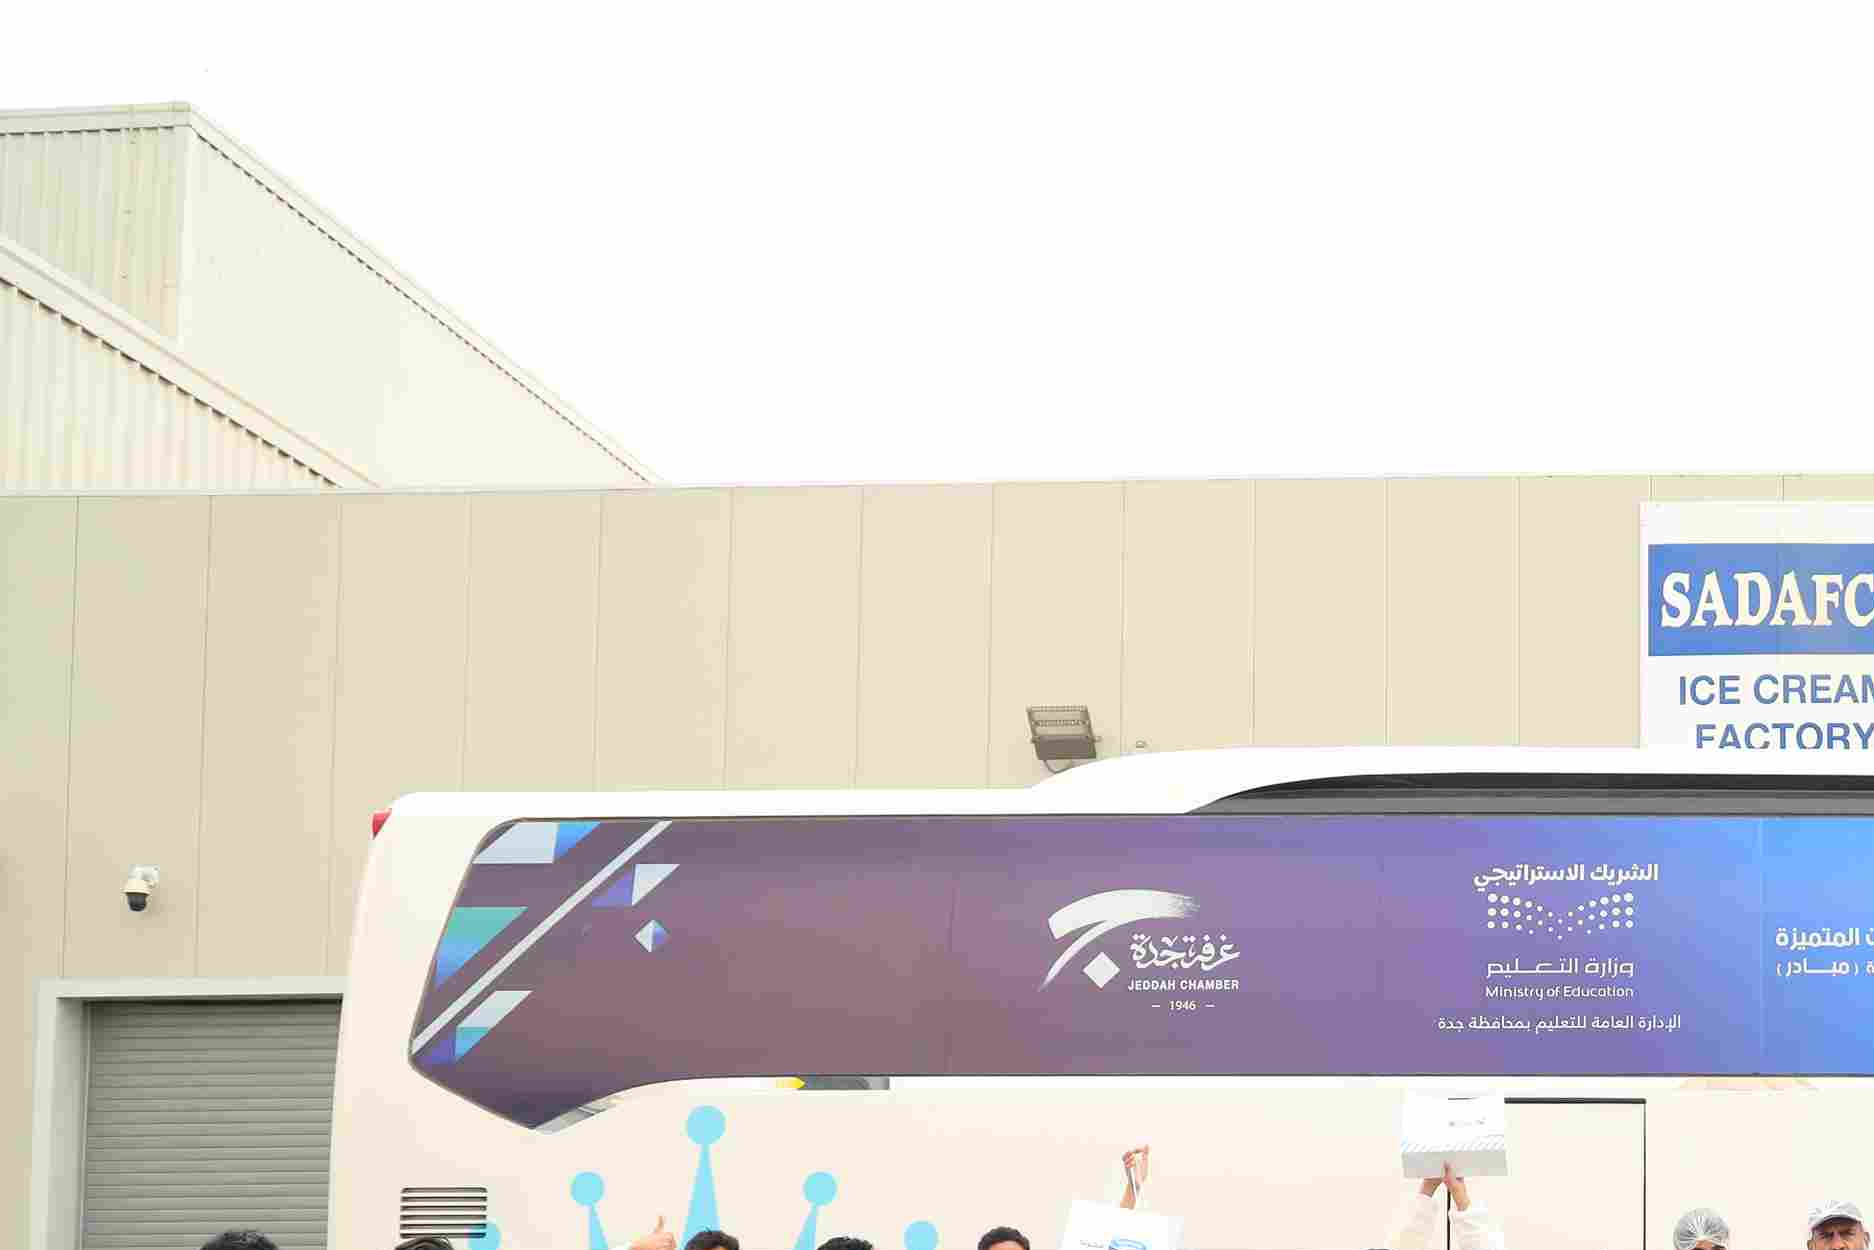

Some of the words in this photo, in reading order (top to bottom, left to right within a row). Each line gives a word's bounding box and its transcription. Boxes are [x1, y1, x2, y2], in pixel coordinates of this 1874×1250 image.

[1679, 674, 1741, 706] ICE
[1473, 863, 1585, 892] الاستراتيجي
[1590, 863, 1659, 886] الشريك
[1775, 927, 1861, 951] المتميزة
[1486, 957, 1579, 978] التعليم
[1584, 957, 1635, 978] وزارة
[1127, 979, 1176, 991] JEDDAH
[1180, 979, 1240, 991] CHAMBER
[1485, 985, 1545, 1001] Ministry
[1547, 985, 1561, 998] of
[1563, 985, 1634, 998] Education
[1168, 999, 1197, 1011] 1946
[1437, 1016, 1466, 1031] جدة
[1468, 1014, 1531, 1031] بمحافظة
[1536, 1014, 1587, 1034] للتعليم
[1591, 1014, 1634, 1030] العامة
